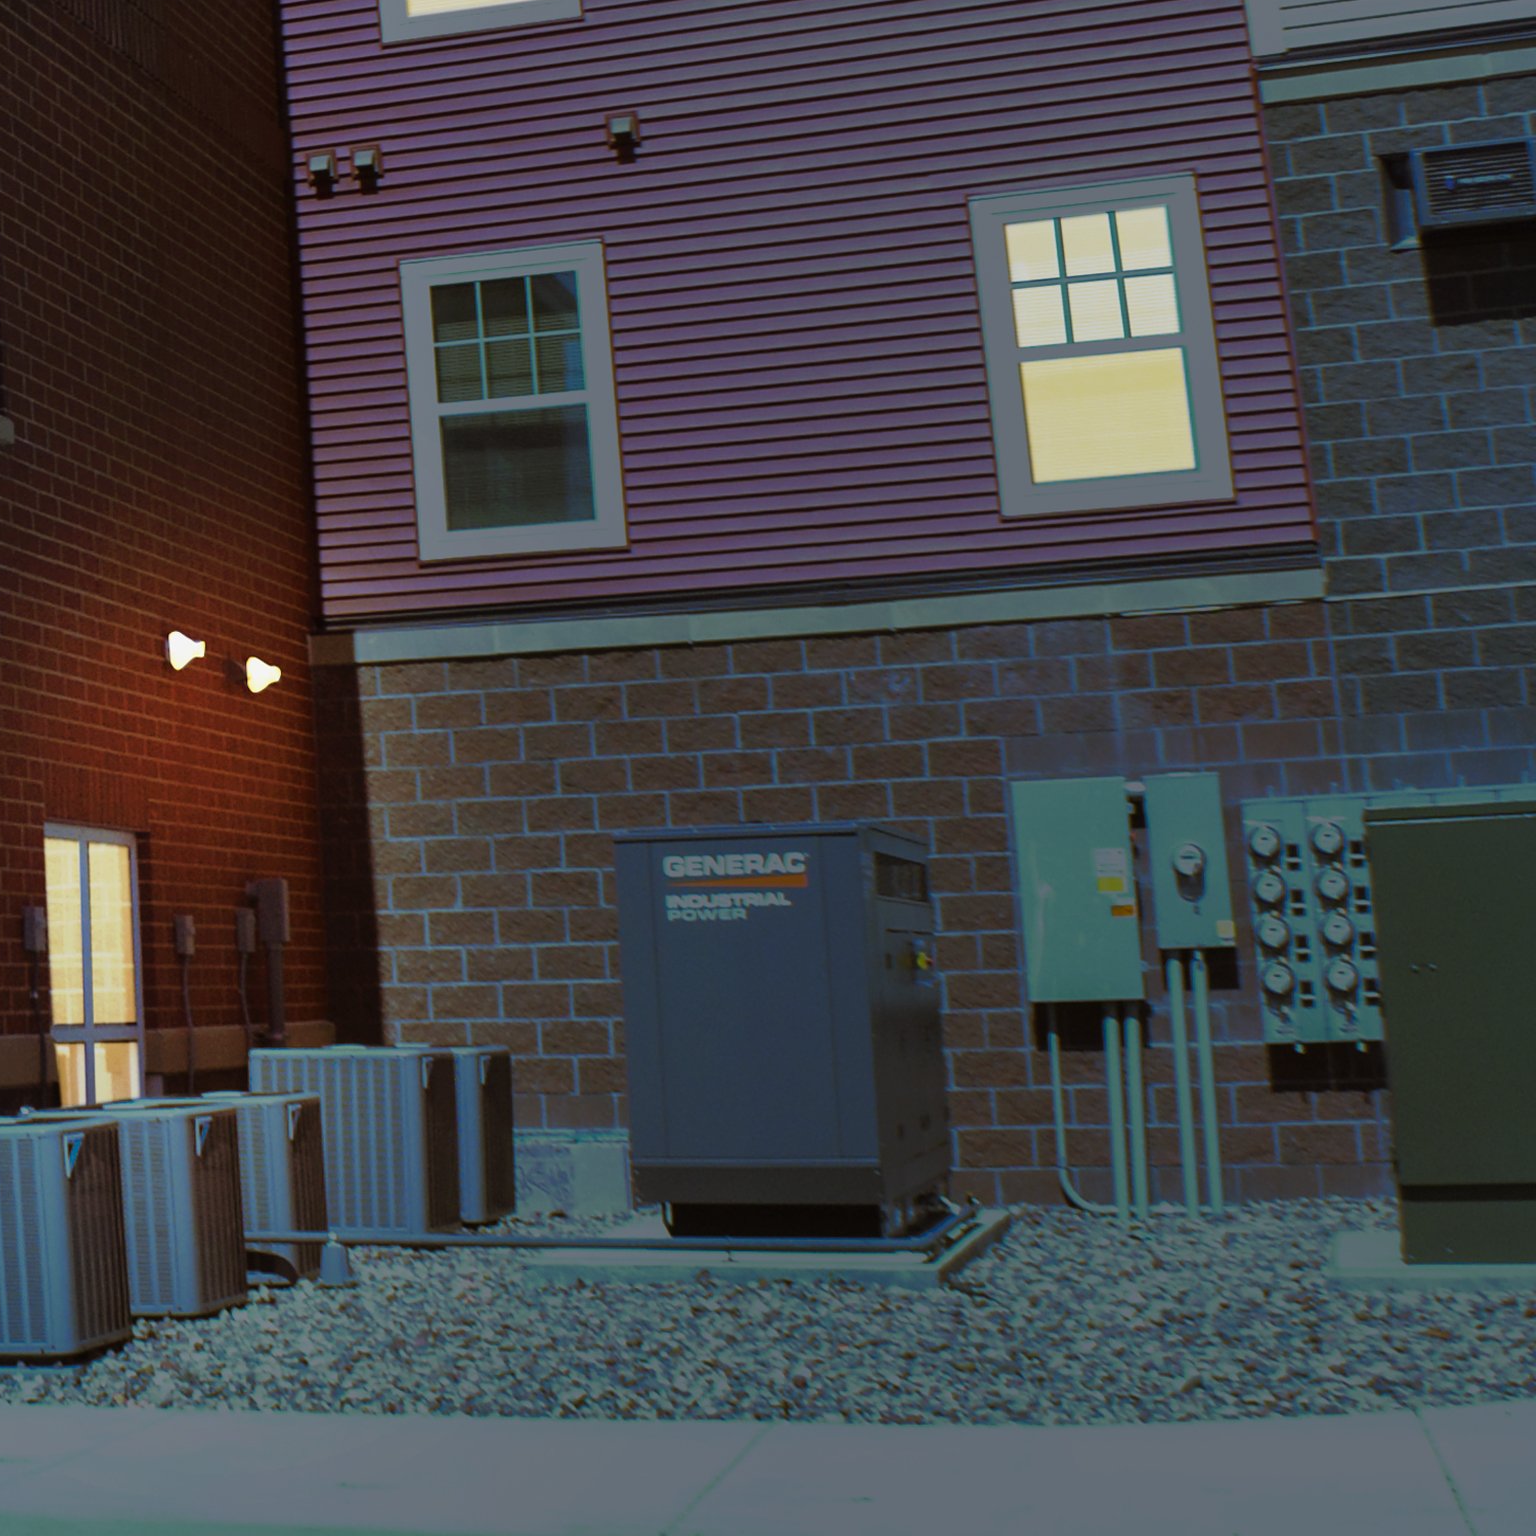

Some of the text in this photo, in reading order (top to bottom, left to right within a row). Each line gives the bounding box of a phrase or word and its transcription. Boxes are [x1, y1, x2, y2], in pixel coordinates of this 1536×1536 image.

[663, 852, 806, 877] GENERAC
[666, 892, 791, 908] INDUSTRIAL
[668, 909, 747, 921] POWER
